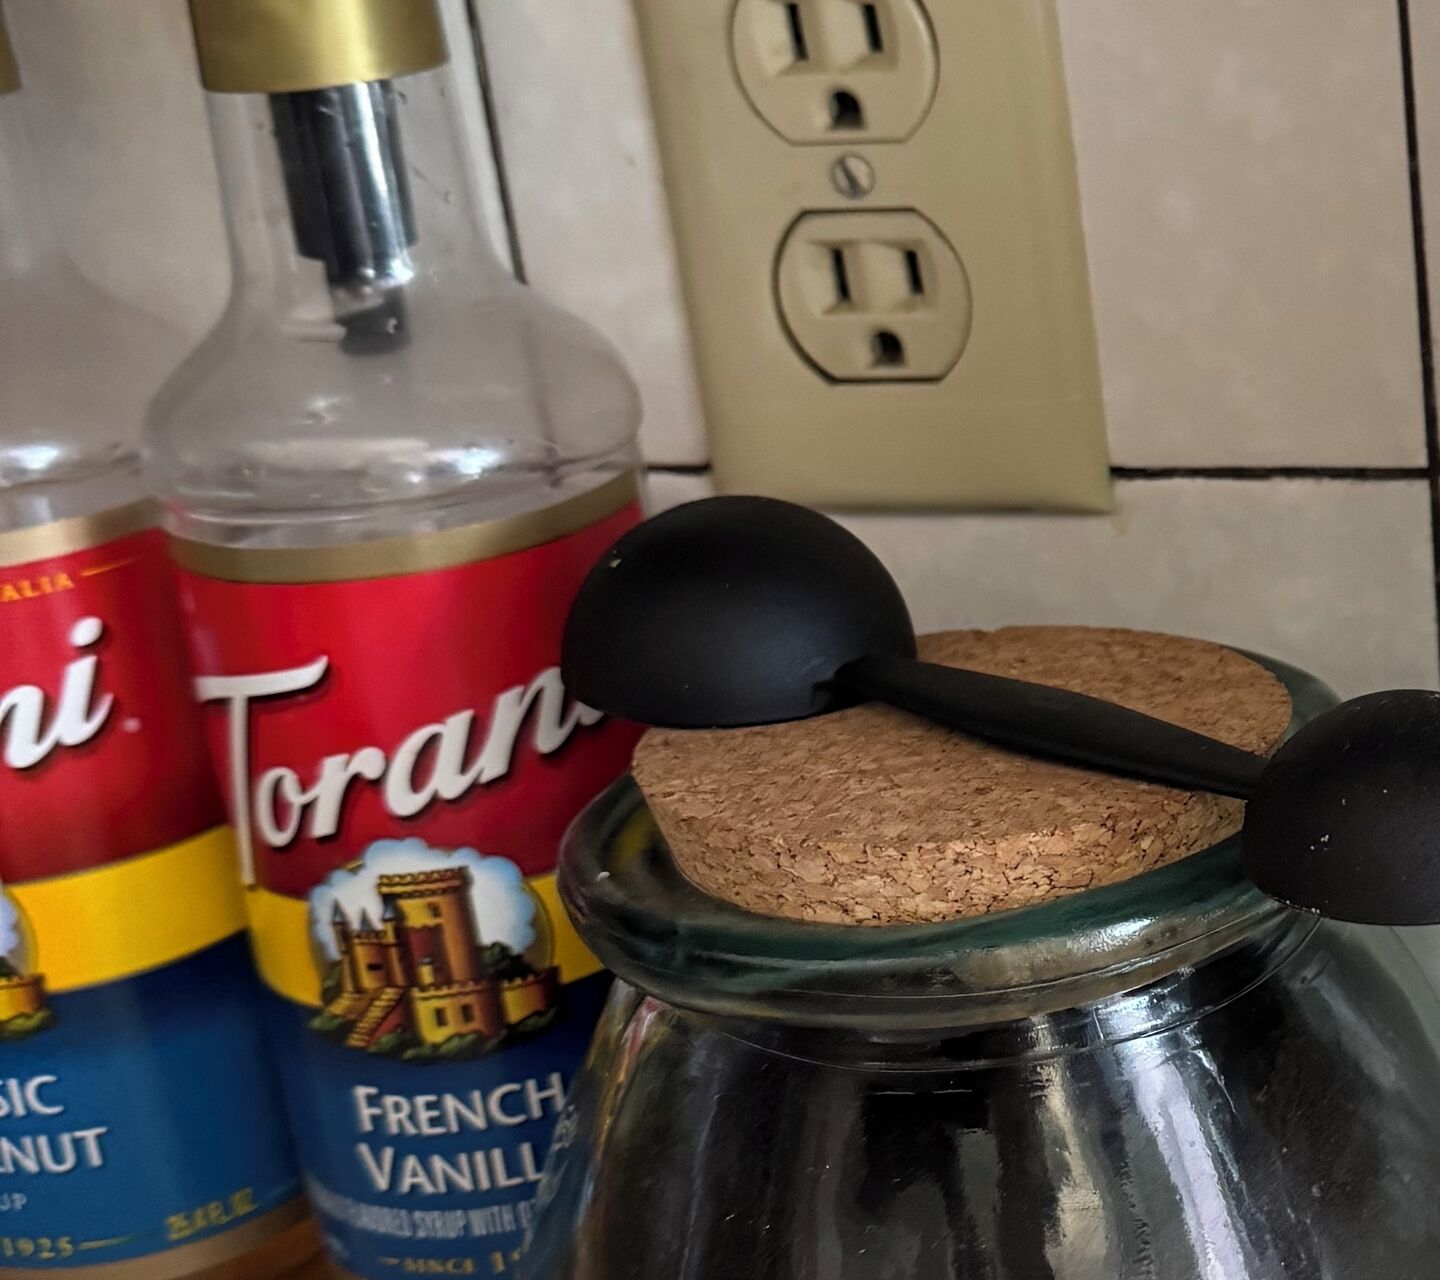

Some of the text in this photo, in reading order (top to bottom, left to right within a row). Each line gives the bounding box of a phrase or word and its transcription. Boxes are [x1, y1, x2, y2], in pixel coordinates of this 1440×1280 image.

[0, 572, 75, 603] ALIA
[0, 615, 115, 770] ni
[194, 654, 605, 889] Toran
[353, 1072, 566, 1137] FRENCH
[0, 1126, 109, 1175] NUT
[356, 1141, 546, 1195] VANILL
